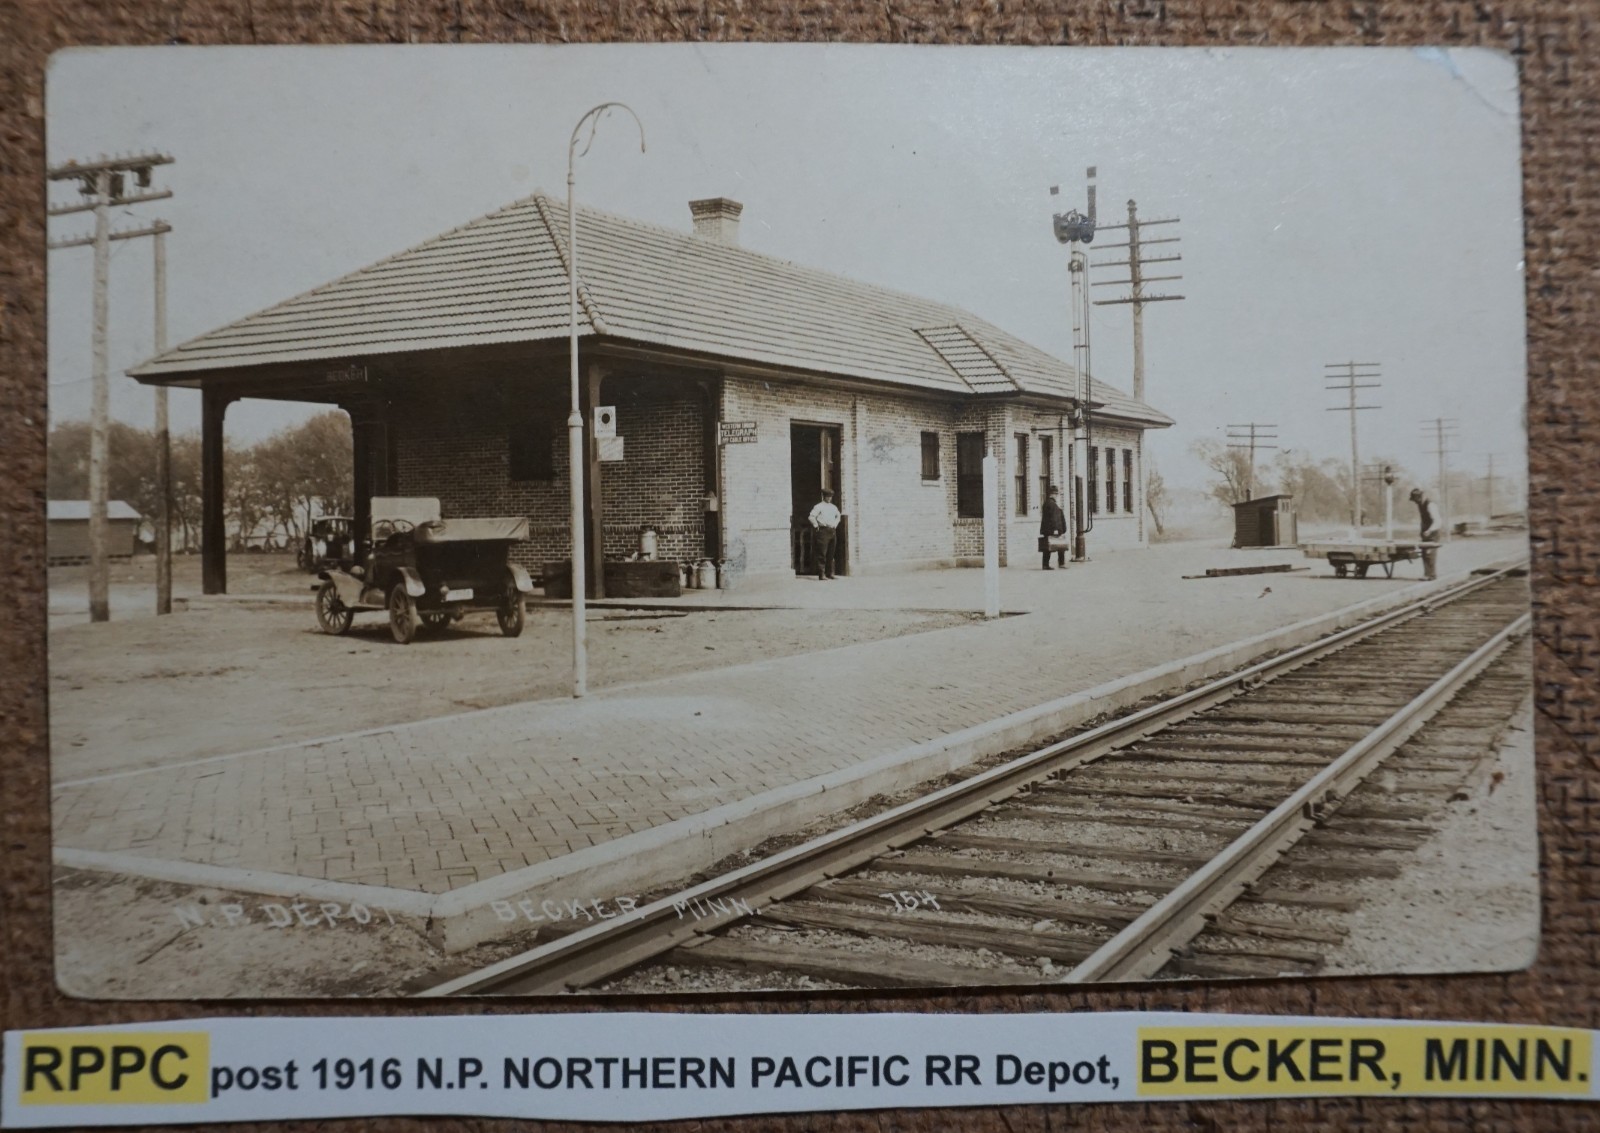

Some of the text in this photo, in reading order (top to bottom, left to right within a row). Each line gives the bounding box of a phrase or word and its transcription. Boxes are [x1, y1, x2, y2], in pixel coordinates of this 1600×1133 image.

[720, 428, 757, 437] TELEGRAPH
[672, 897, 761, 920] MINN.
[24, 1038, 1588, 1098] RPPC post 1916 N.P. NORTHERN PACIFIC RR Depot, BECKER, MINN.
